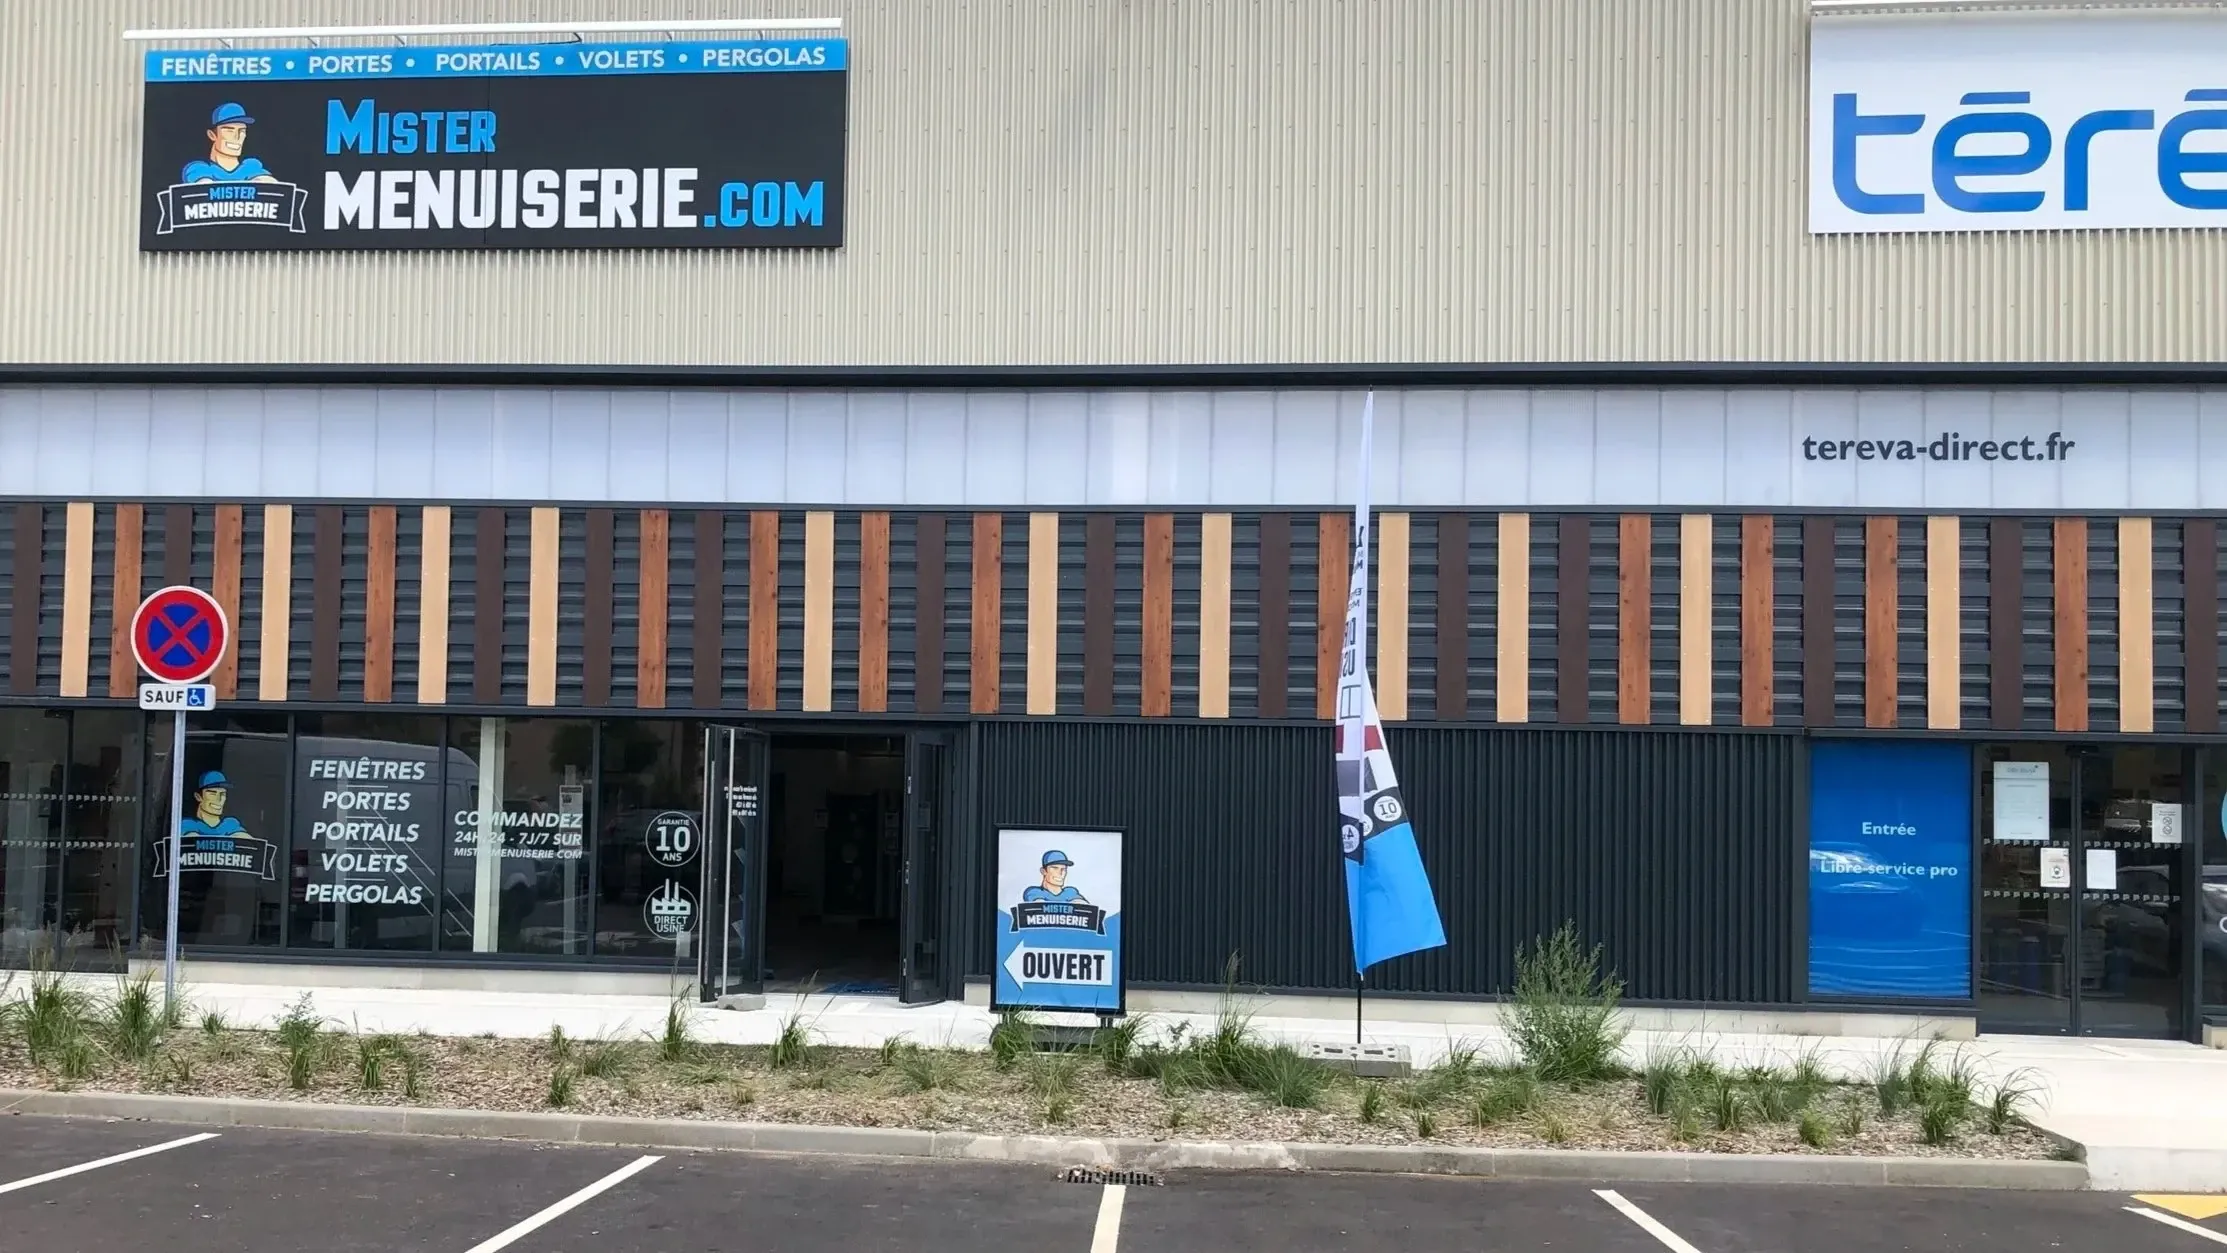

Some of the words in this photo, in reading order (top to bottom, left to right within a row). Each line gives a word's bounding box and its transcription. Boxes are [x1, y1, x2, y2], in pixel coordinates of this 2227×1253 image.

[162, 53, 272, 76] FENÊTRES
[309, 55, 393, 74] PORTES
[436, 52, 540, 72] PORTAILS
[578, 49, 665, 69] VOLETS
[703, 47, 826, 67] PERGOLAS
[208, 186, 256, 201] MISTER
[184, 200, 279, 221] MENUISERIE
[1802, 432, 2076, 461] tereva-direct.fr
[145, 690, 184, 703] SAUF
[309, 757, 426, 780] FENÊTRES
[322, 791, 411, 811] PORTES
[1378, 802, 1397, 816] 10
[454, 810, 583, 828] COMMANDEZ
[657, 818, 690, 826] GARANTIE
[311, 822, 420, 842] PORTAILS
[1862, 822, 1916, 836] Entrée
[196, 840, 235, 851] MISTER
[454, 831, 506, 844] 24H24
[519, 833, 550, 845] 7J/7
[553, 833, 582, 846] SUR
[656, 826, 691, 852] 10
[178, 852, 253, 868] MENUISERIE
[321, 853, 408, 873] VOLETS
[662, 853, 682, 862] ANS
[1820, 862, 1925, 876] Libre-service
[1930, 864, 1958, 878] pro
[305, 884, 422, 905] PERGOLAS
[1043, 904, 1074, 914] MISTER
[654, 916, 688, 925] DIRECT
[656, 924, 685, 933] USINE
[1027, 915, 1089, 928] MENUISERIE
[1023, 952, 1105, 981] OUVERT
